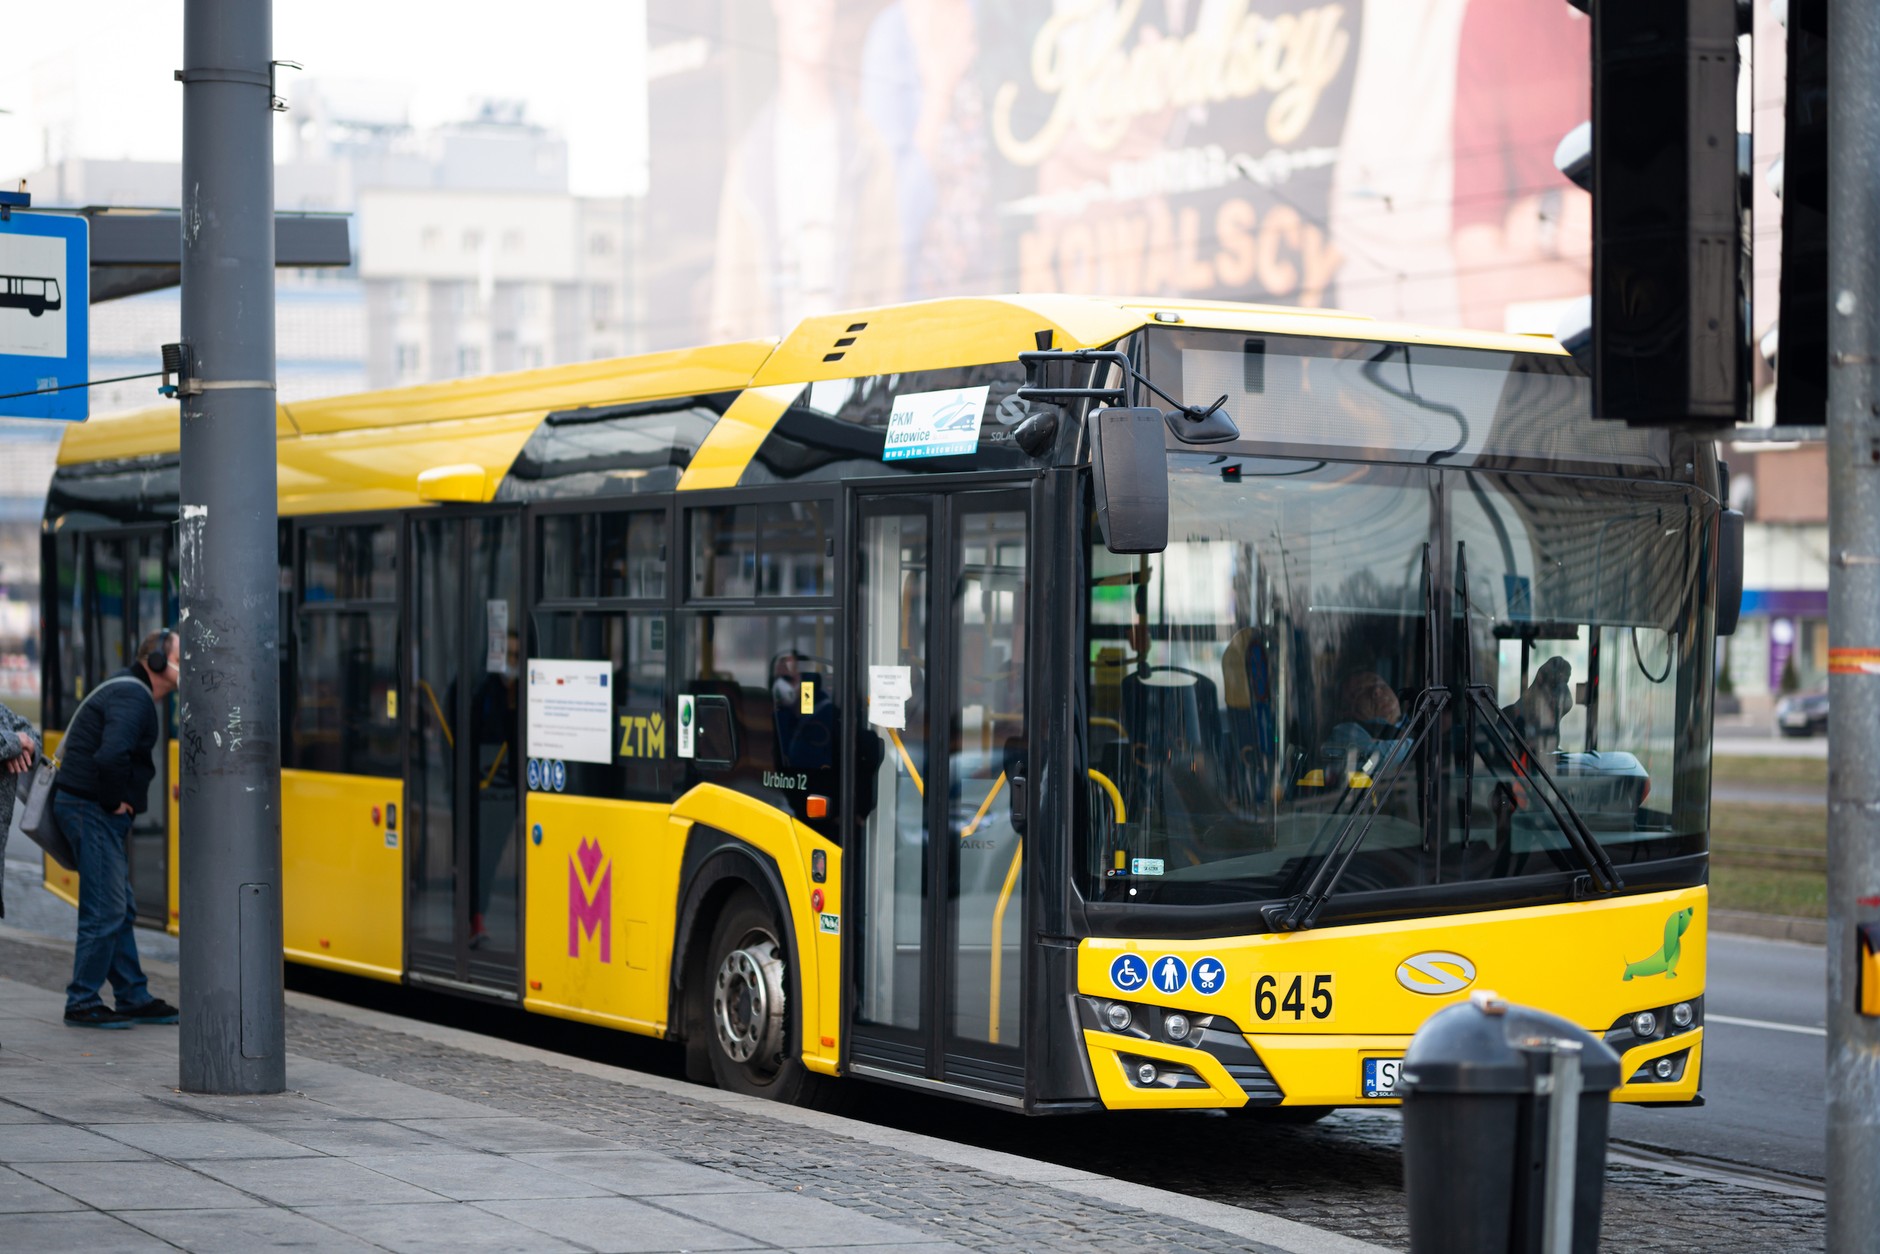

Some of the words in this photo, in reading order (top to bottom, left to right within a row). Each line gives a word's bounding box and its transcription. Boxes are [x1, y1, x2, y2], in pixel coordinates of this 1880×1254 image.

[891, 411, 913, 426] PKM
[888, 427, 931, 444] Katowice
[619, 712, 666, 760] ZTM
[763, 770, 796, 789] Urbino
[797, 773, 808, 790] 12
[1254, 974, 1334, 1021] 645
[1366, 1079, 1376, 1087] PL
